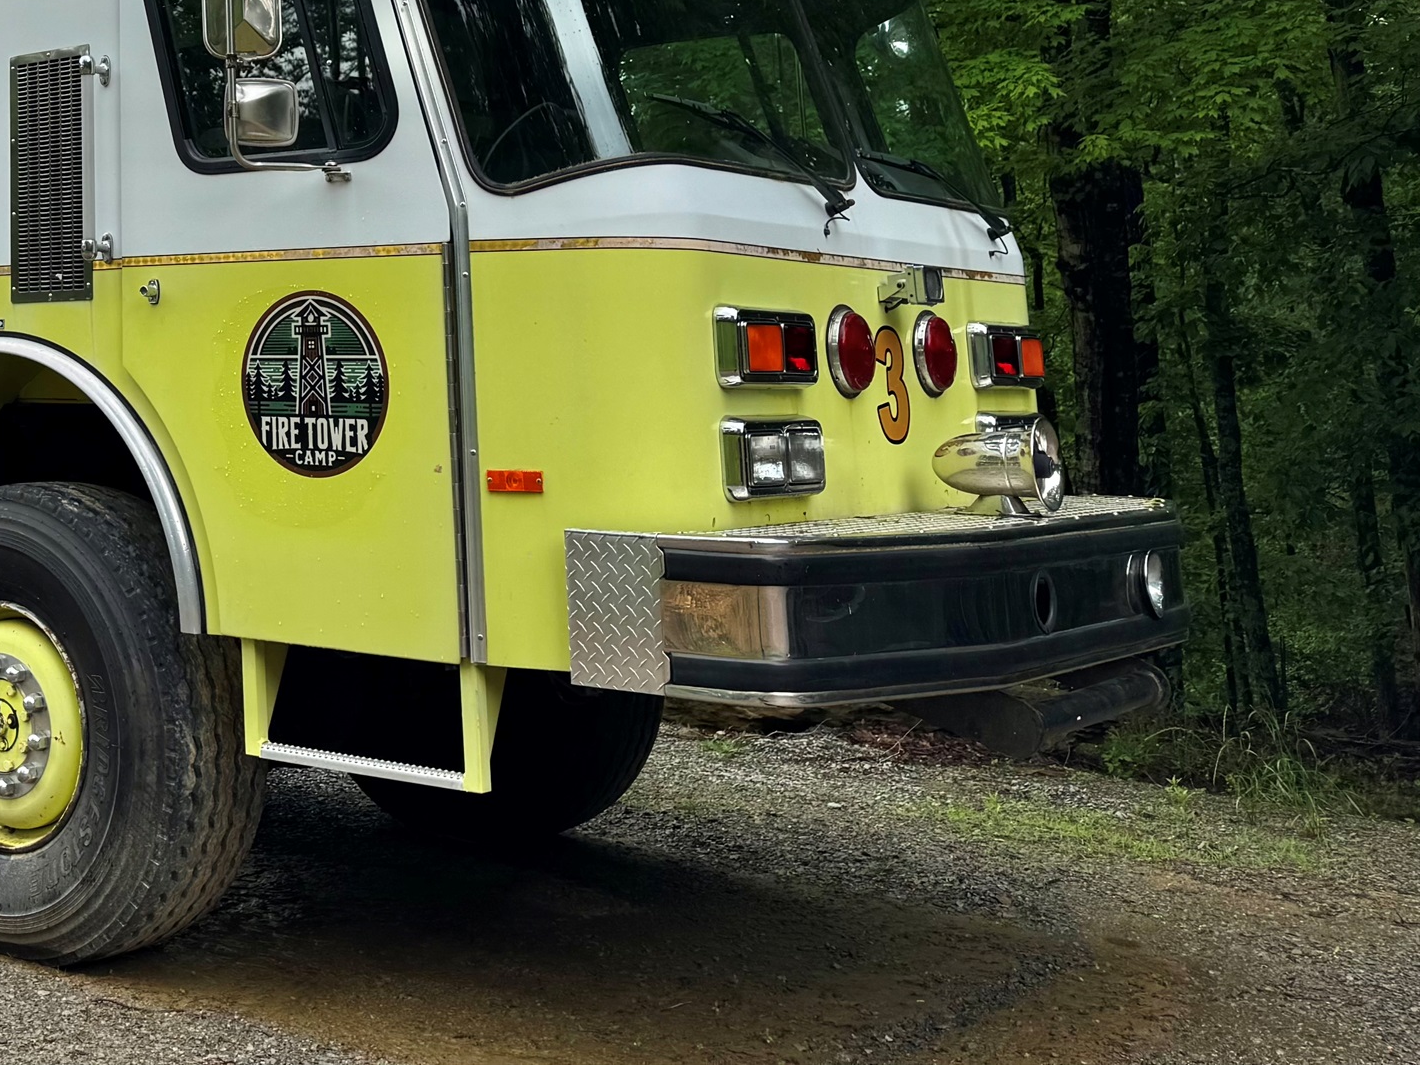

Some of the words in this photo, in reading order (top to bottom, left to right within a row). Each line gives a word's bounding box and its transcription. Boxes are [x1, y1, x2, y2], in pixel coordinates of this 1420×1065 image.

[874, 325, 911, 445] 3
[260, 415, 301, 451] FIRE
[304, 417, 369, 455] TOWER
[295, 449, 337, 467] CAMP
